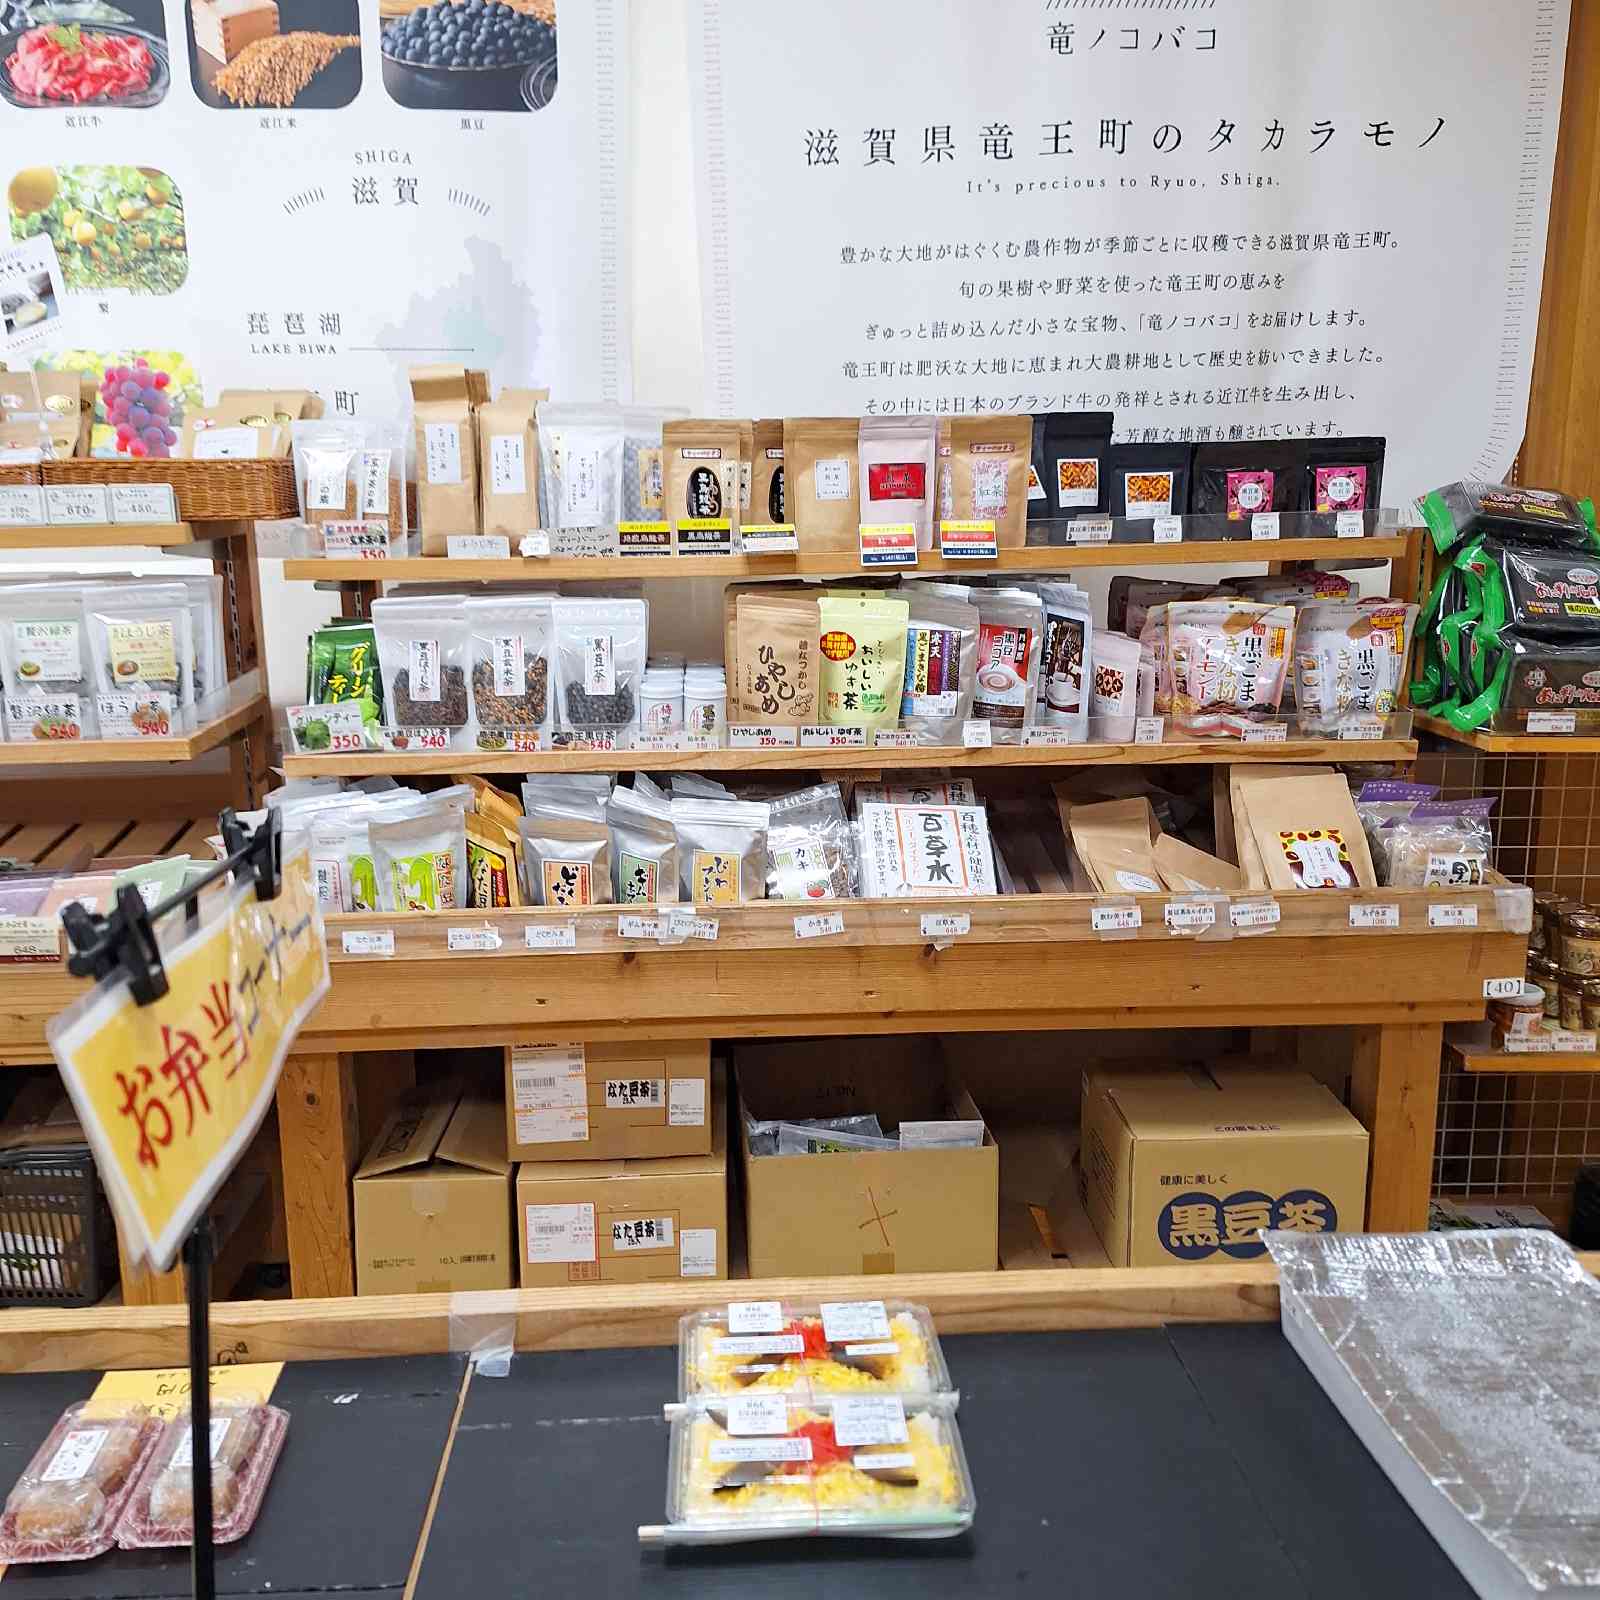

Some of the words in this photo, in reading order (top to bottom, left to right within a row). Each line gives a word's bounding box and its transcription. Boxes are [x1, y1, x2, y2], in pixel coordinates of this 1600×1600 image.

[1047, 20, 1217, 56] 竜ノコバコ
[803, 116, 1446, 167] 滋賀県竜王町のタカラモノ
[353, 149, 413, 165] SHIGA
[351, 175, 419, 207] 滋賀
[967, 179, 1001, 193] It's
[1015, 175, 1106, 195] precious
[1120, 177, 1137, 188] to
[1150, 174, 1206, 192] Ryuo,
[1220, 173, 1281, 188] Shiga.
[247, 311, 342, 337] 琵琶湖
[250, 343, 292, 354] LAKE
[297, 343, 338, 355] BIWA
[592, 638, 606, 682] 黒豆茶
[991, 635, 1004, 670] ココア
[860, 644, 874, 691] おいしい
[1239, 635, 1264, 703] 黒ごま
[1356, 649, 1376, 712] 黒ごま
[332, 733, 361, 749] 350
[419, 735, 446, 749] 540
[732, 728, 772, 737] ひやしあめ
[759, 736, 777, 746] 350
[829, 736, 847, 745] 350
[514, 740, 537, 752] 540
[919, 812, 953, 884] 百草水
[115, 979, 251, 1170] お弁当
[607, 1080, 650, 1098] なた豆茶
[1159, 1173, 1229, 1187] 健康に美しく
[612, 1220, 656, 1240] なた豆茶
[1168, 1199, 1327, 1249] 黒豆茶
